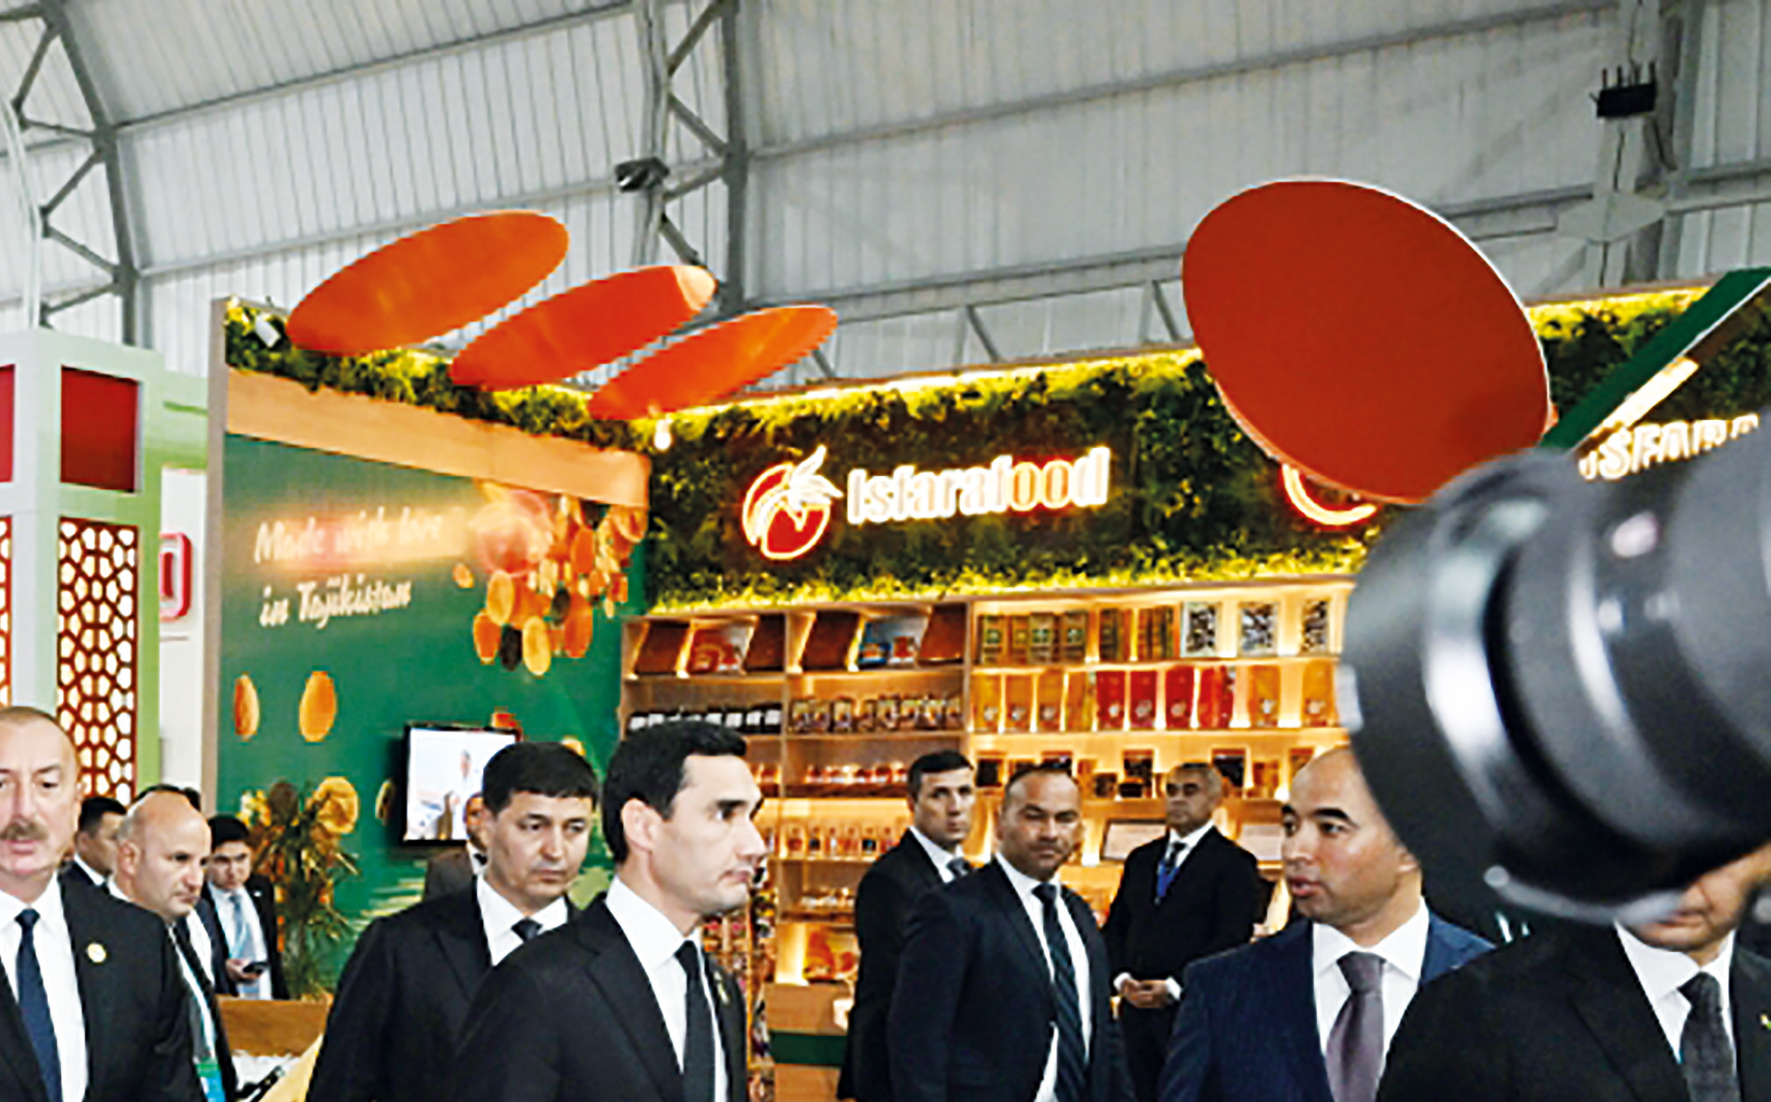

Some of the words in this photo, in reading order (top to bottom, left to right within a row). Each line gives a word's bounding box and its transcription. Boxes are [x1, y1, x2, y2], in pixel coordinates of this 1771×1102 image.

[847, 446, 1111, 524] Isfarafood
[255, 515, 326, 564] Made
[334, 505, 390, 554] with
[259, 585, 290, 627] in
[296, 573, 412, 629] Tajikistan
